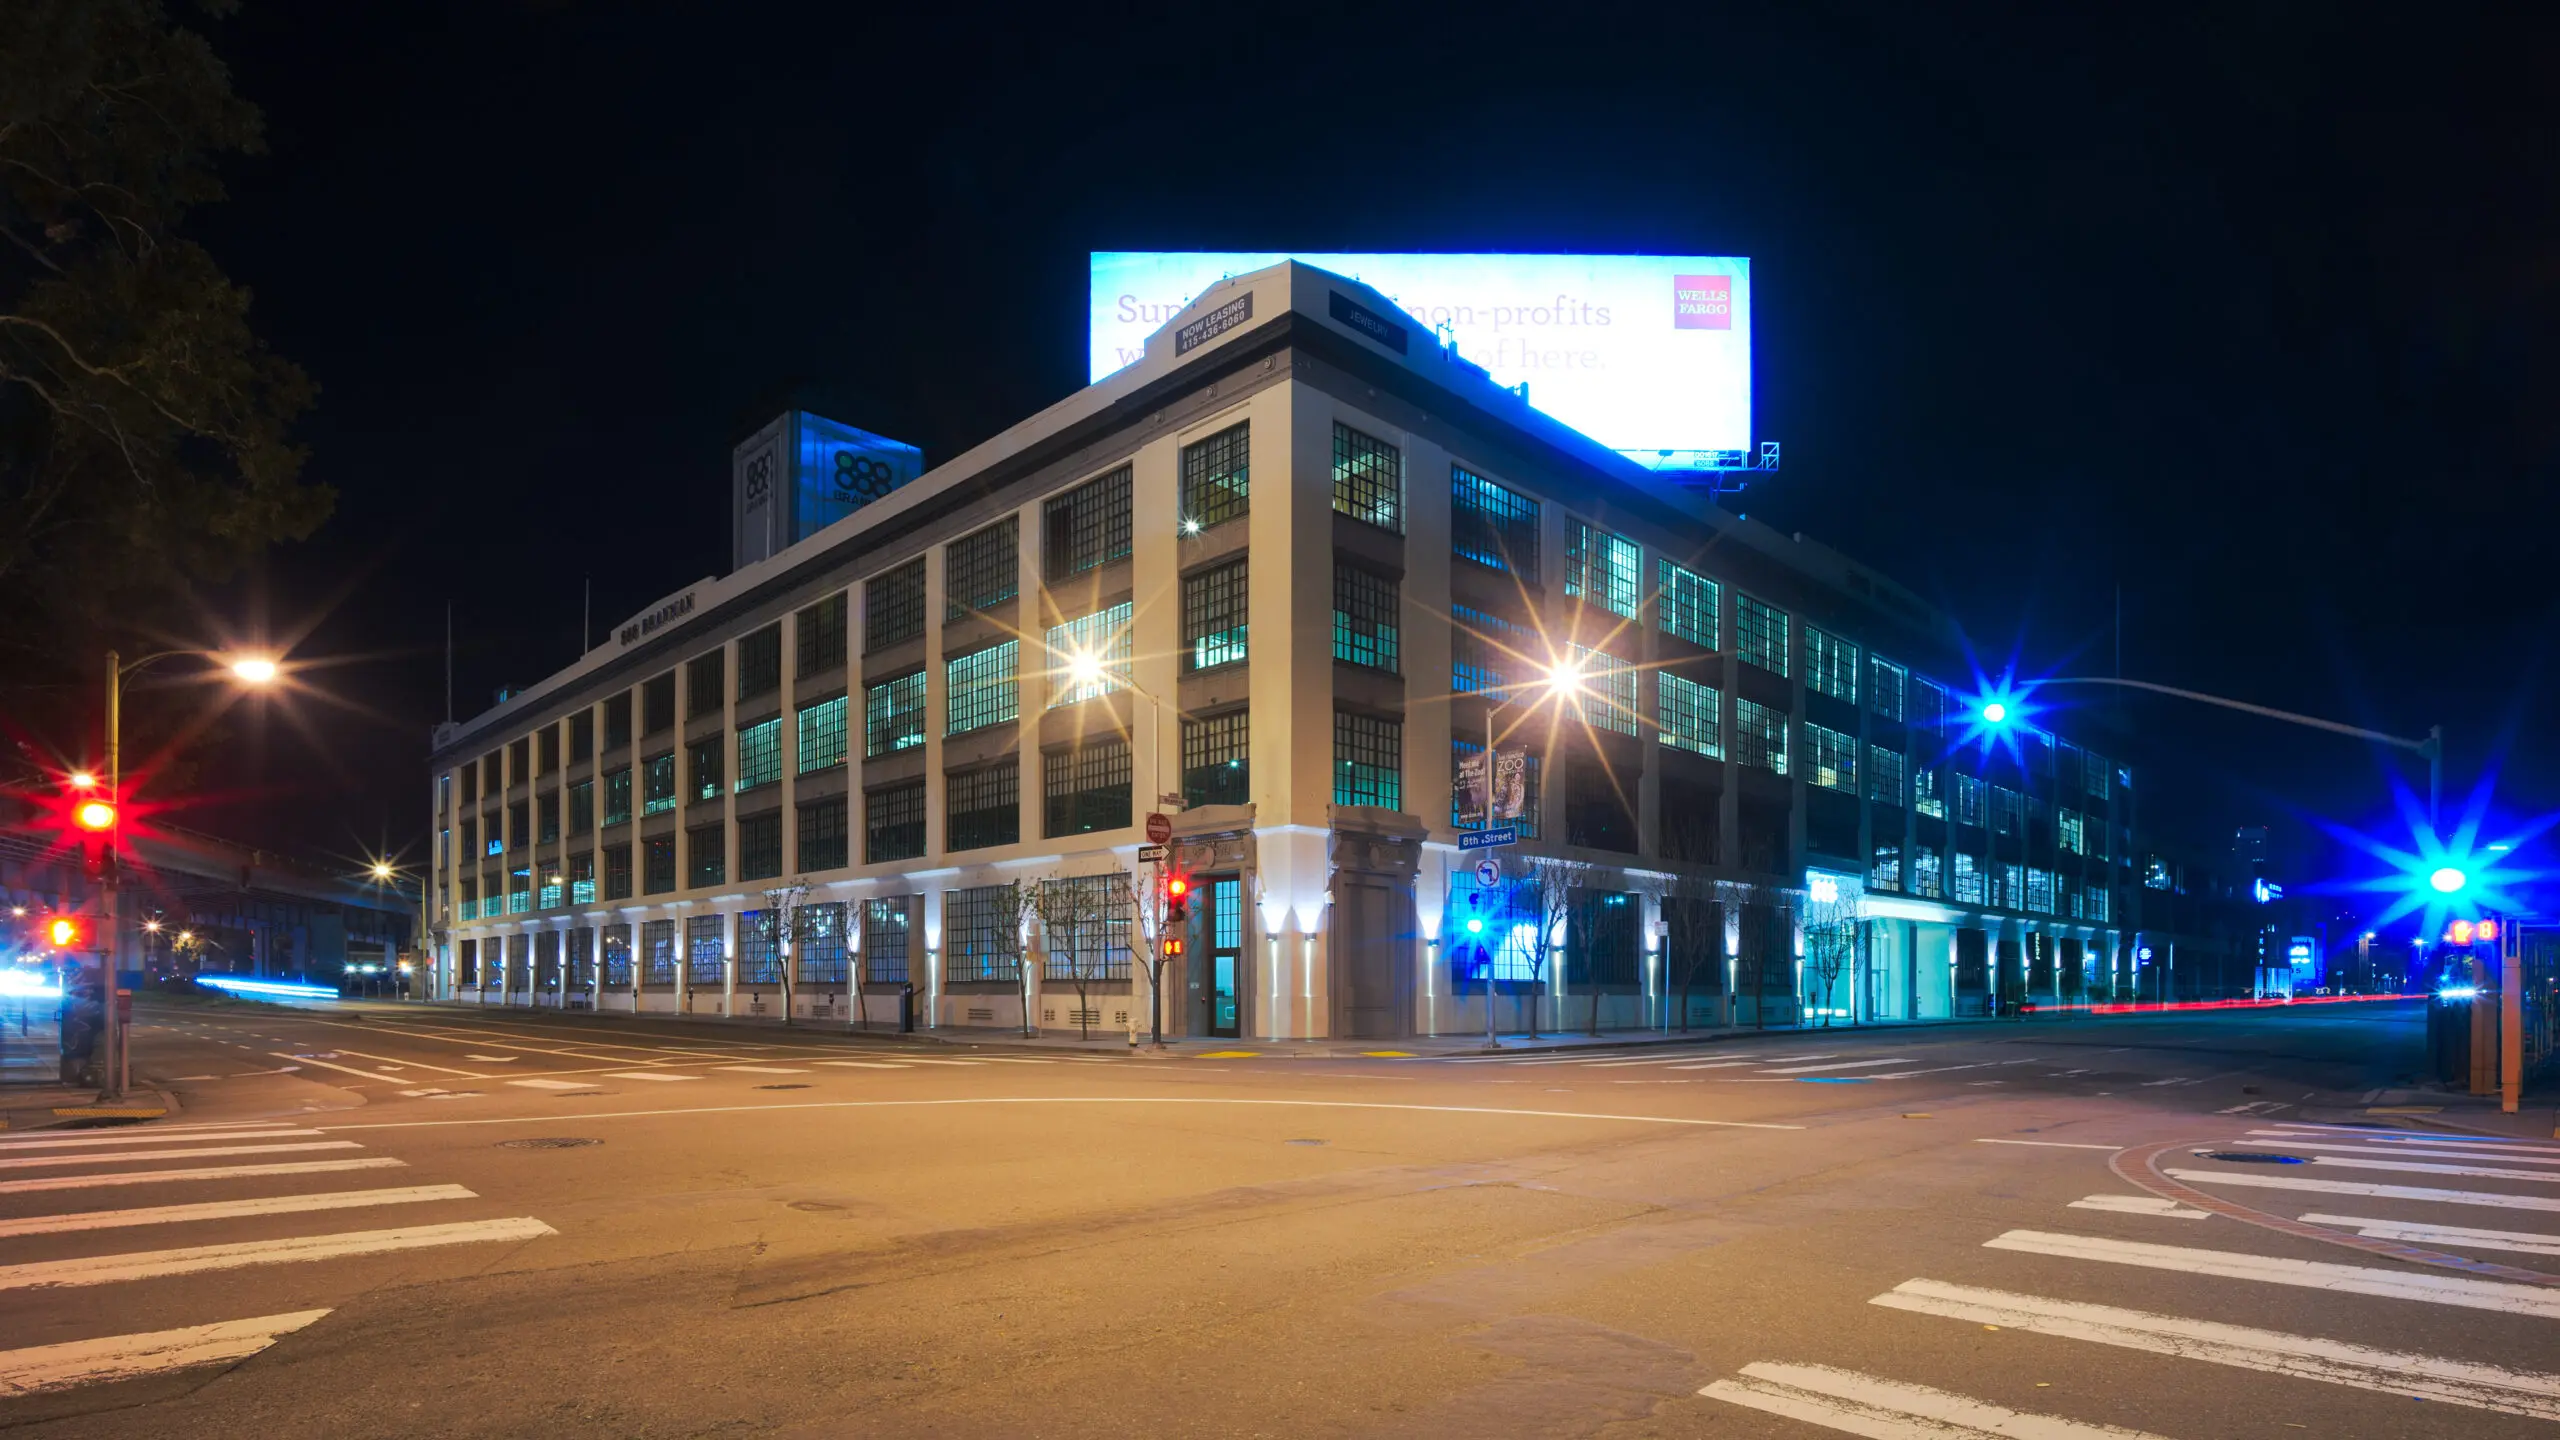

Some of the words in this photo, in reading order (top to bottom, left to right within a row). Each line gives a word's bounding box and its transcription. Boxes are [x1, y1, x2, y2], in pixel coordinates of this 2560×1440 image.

[1677, 289, 1728, 301] WELLS
[1679, 303, 1728, 315] FARGO
[1182, 320, 1204, 340] NOW
[1205, 298, 1245, 327] LEASING
[1349, 309, 1389, 337] JEWELRY
[1182, 310, 1245, 350] 415-436-6060
[1517, 338, 1607, 368] here.
[1497, 758, 1524, 771] ZOO
[1462, 836, 1479, 846] 8th
[1484, 831, 1512, 844] Street
[1141, 851, 1151, 859] ONE
